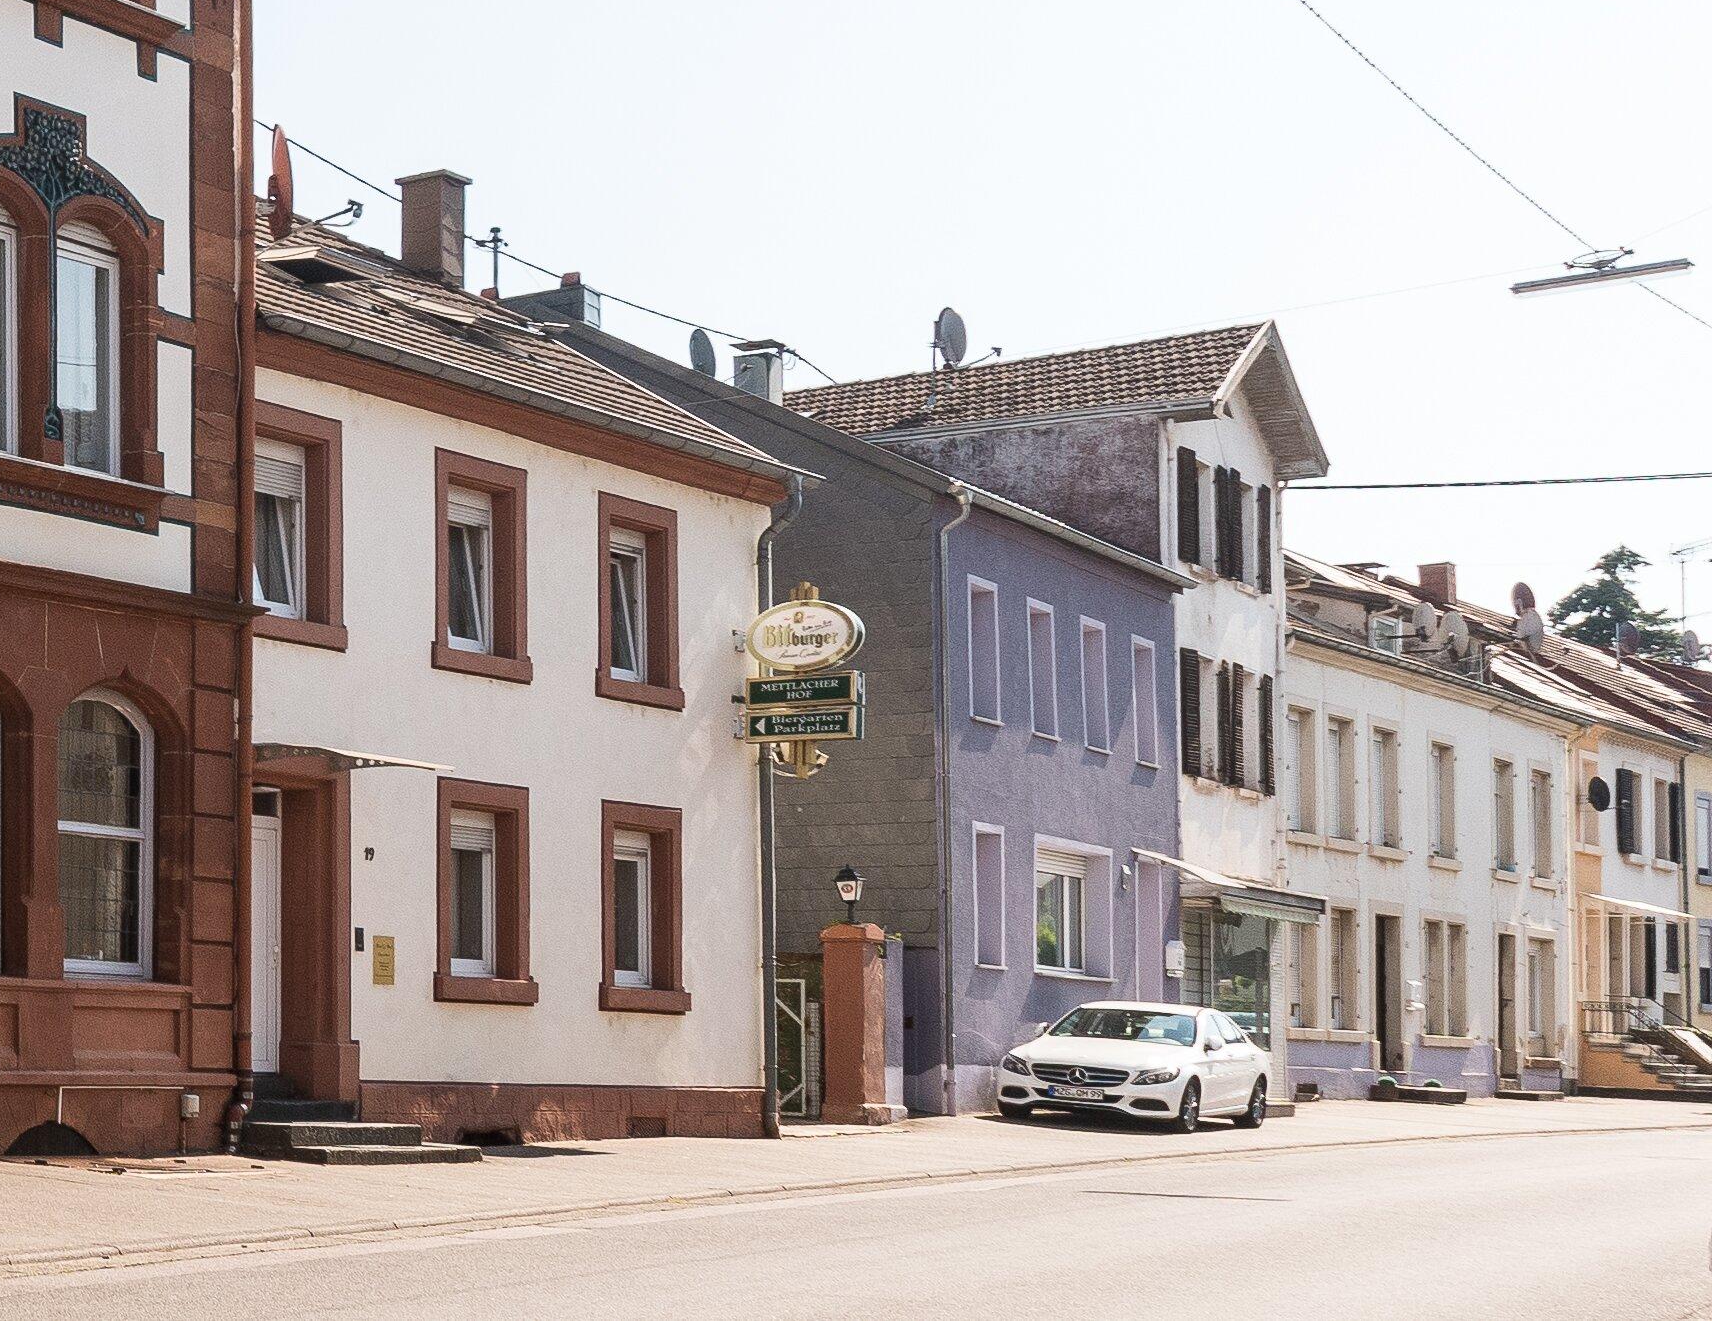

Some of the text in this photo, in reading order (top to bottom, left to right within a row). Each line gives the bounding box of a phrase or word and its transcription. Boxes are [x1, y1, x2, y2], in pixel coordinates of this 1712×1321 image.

[762, 623, 839, 648] Bitburger
[760, 678, 839, 692] METTLACHER
[786, 689, 813, 699] HOF
[771, 713, 843, 725] Biergarten
[773, 722, 841, 734] Parkplatz
[363, 847, 375, 861] 19
